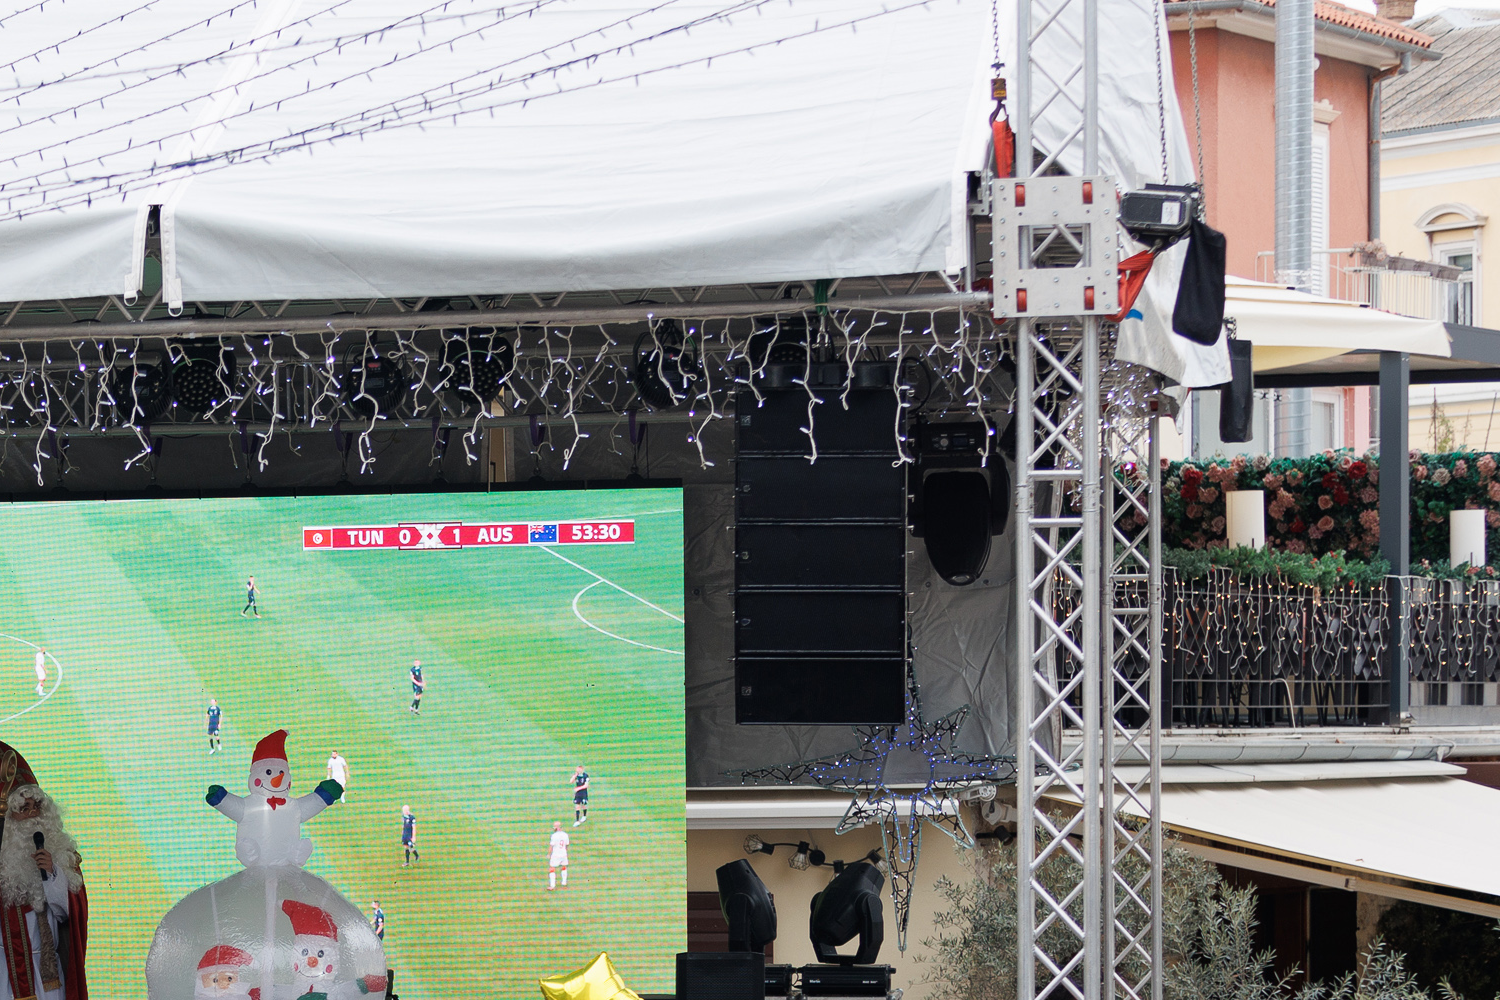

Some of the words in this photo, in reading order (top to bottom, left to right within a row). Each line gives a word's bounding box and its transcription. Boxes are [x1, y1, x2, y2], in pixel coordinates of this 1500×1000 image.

[347, 530, 384, 545] TUN
[399, 529, 411, 544] 0
[452, 529, 461, 543] 1
[477, 527, 514, 542] AUS
[571, 525, 621, 540] 53:30
